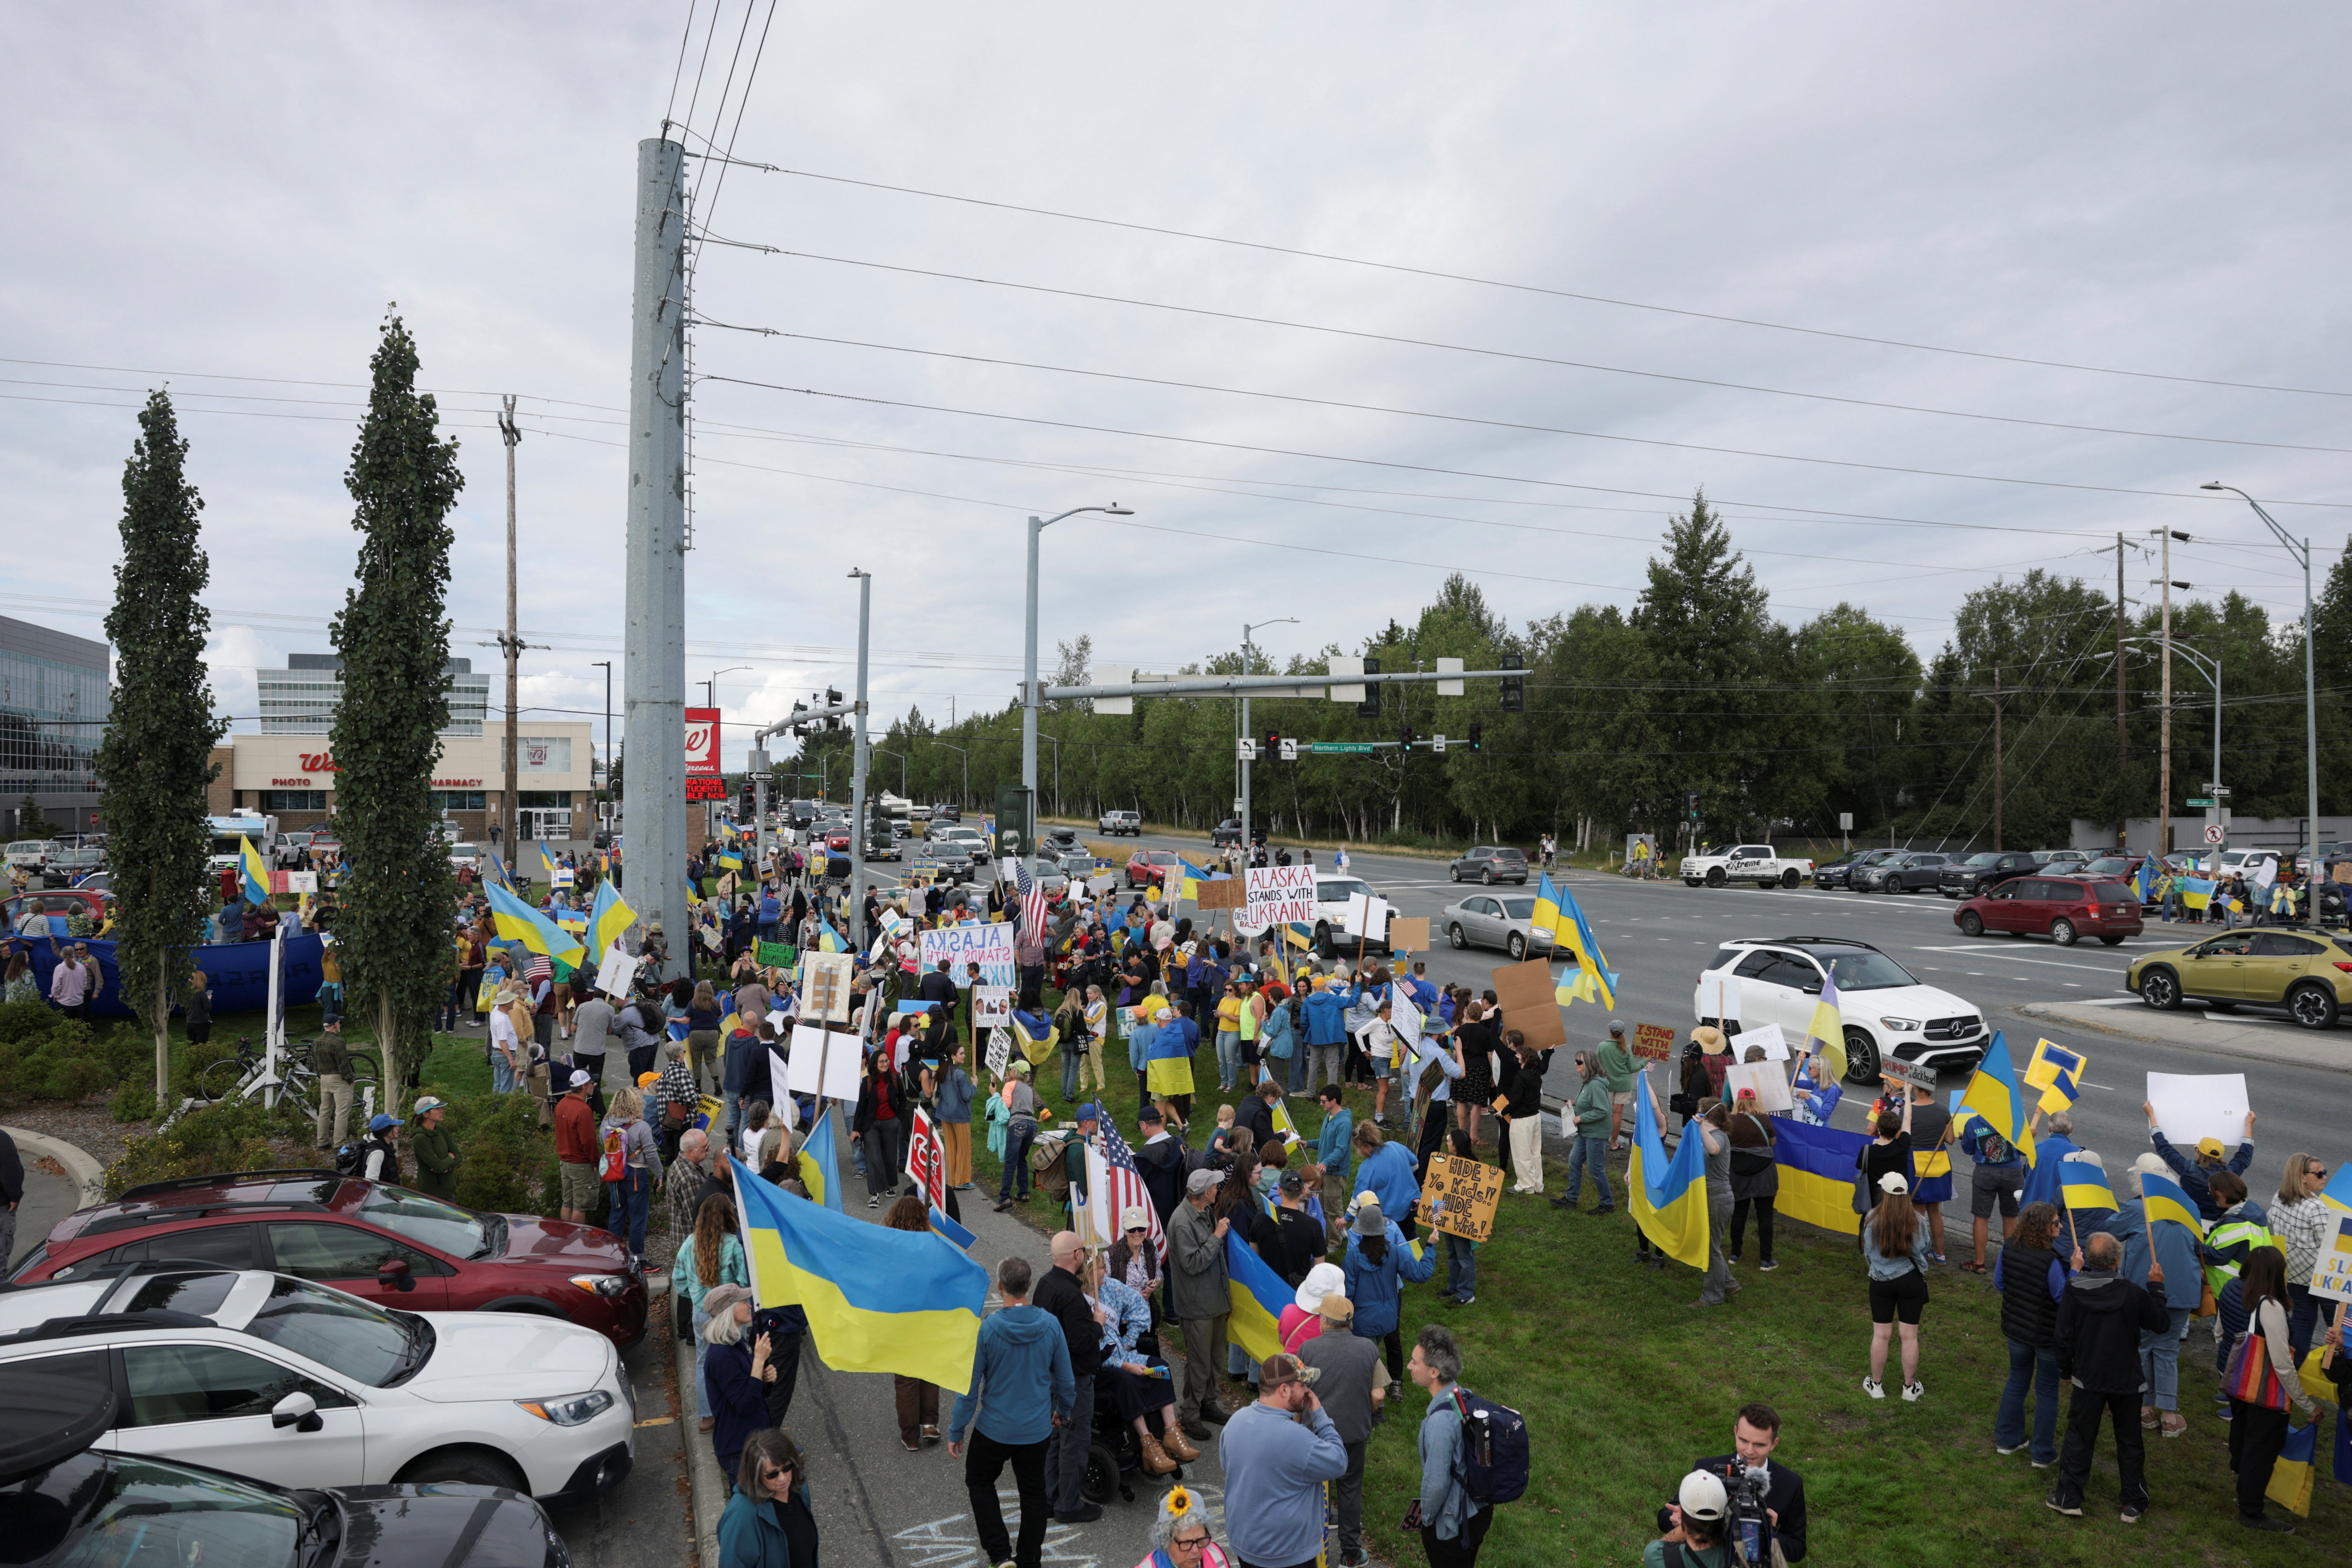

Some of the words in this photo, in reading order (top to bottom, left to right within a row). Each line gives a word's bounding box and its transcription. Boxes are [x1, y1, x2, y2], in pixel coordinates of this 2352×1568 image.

[1250, 866, 1313, 890] ALASKA
[1248, 889, 1282, 903] STANDS
[1287, 888, 1312, 899] WITH
[1250, 901, 1316, 924] UKRAINE
[993, 986, 1009, 997] FASCISTS
[976, 1017, 988, 1027] FROM
[988, 1017, 995, 1026] MY
[996, 1016, 1008, 1027] HOUSE
[1636, 1025, 1645, 1035] I
[1644, 1026, 1675, 1040] STAND
[1740, 1029, 1776, 1046] SUPPORT
[992, 1036, 1008, 1057] FELONS
[1641, 1036, 1669, 1049] WITH
[989, 1051, 1003, 1070] WELCOME
[995, 1051, 1005, 1062] NOT
[1631, 1045, 1670, 1062] UKRAINE
[989, 1059, 1001, 1075] HERE!
[1912, 1067, 1935, 1086] dickhead
[698, 1103, 711, 1112] OFF!
[703, 1095, 722, 1108] HANDS
[1449, 1158, 1481, 1182] HIDE
[1428, 1173, 1445, 1191] Yo
[1450, 1178, 1497, 1206] Kids!!
[1442, 1193, 1473, 1218] HIDE
[1454, 1217, 1487, 1239] Wife!
